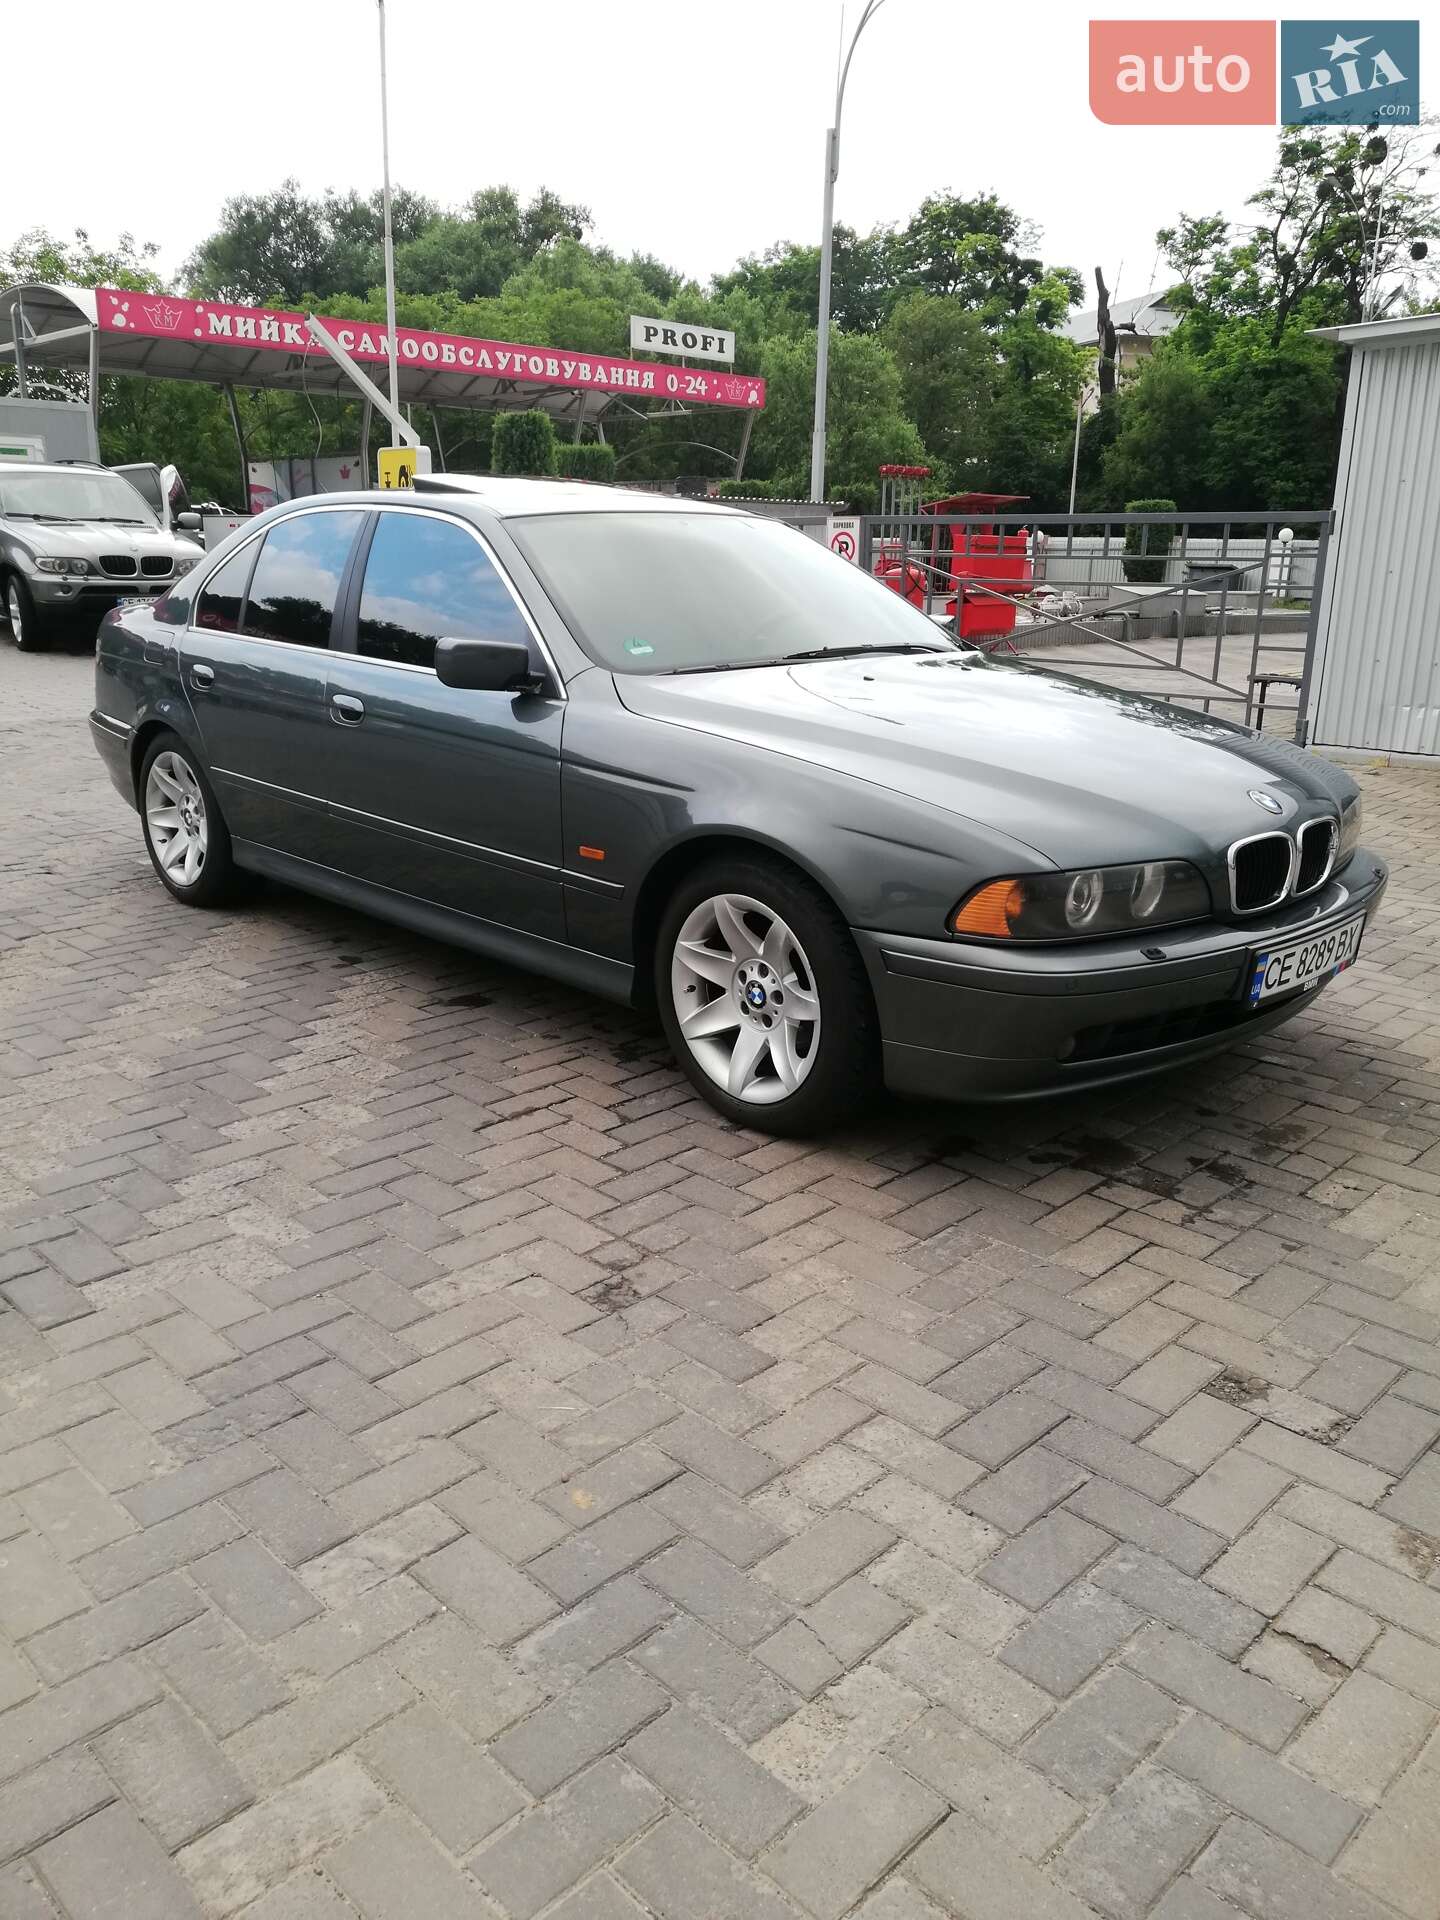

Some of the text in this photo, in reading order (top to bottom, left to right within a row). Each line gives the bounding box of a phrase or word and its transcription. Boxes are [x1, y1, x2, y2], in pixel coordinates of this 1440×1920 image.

[337, 330, 655, 390] САМООБСЛУГОВУВАННЯ
[666, 376, 708, 396] 0-24
[643, 325, 726, 354] PROFI
[1265, 924, 1358, 989] CE 8289 BX
